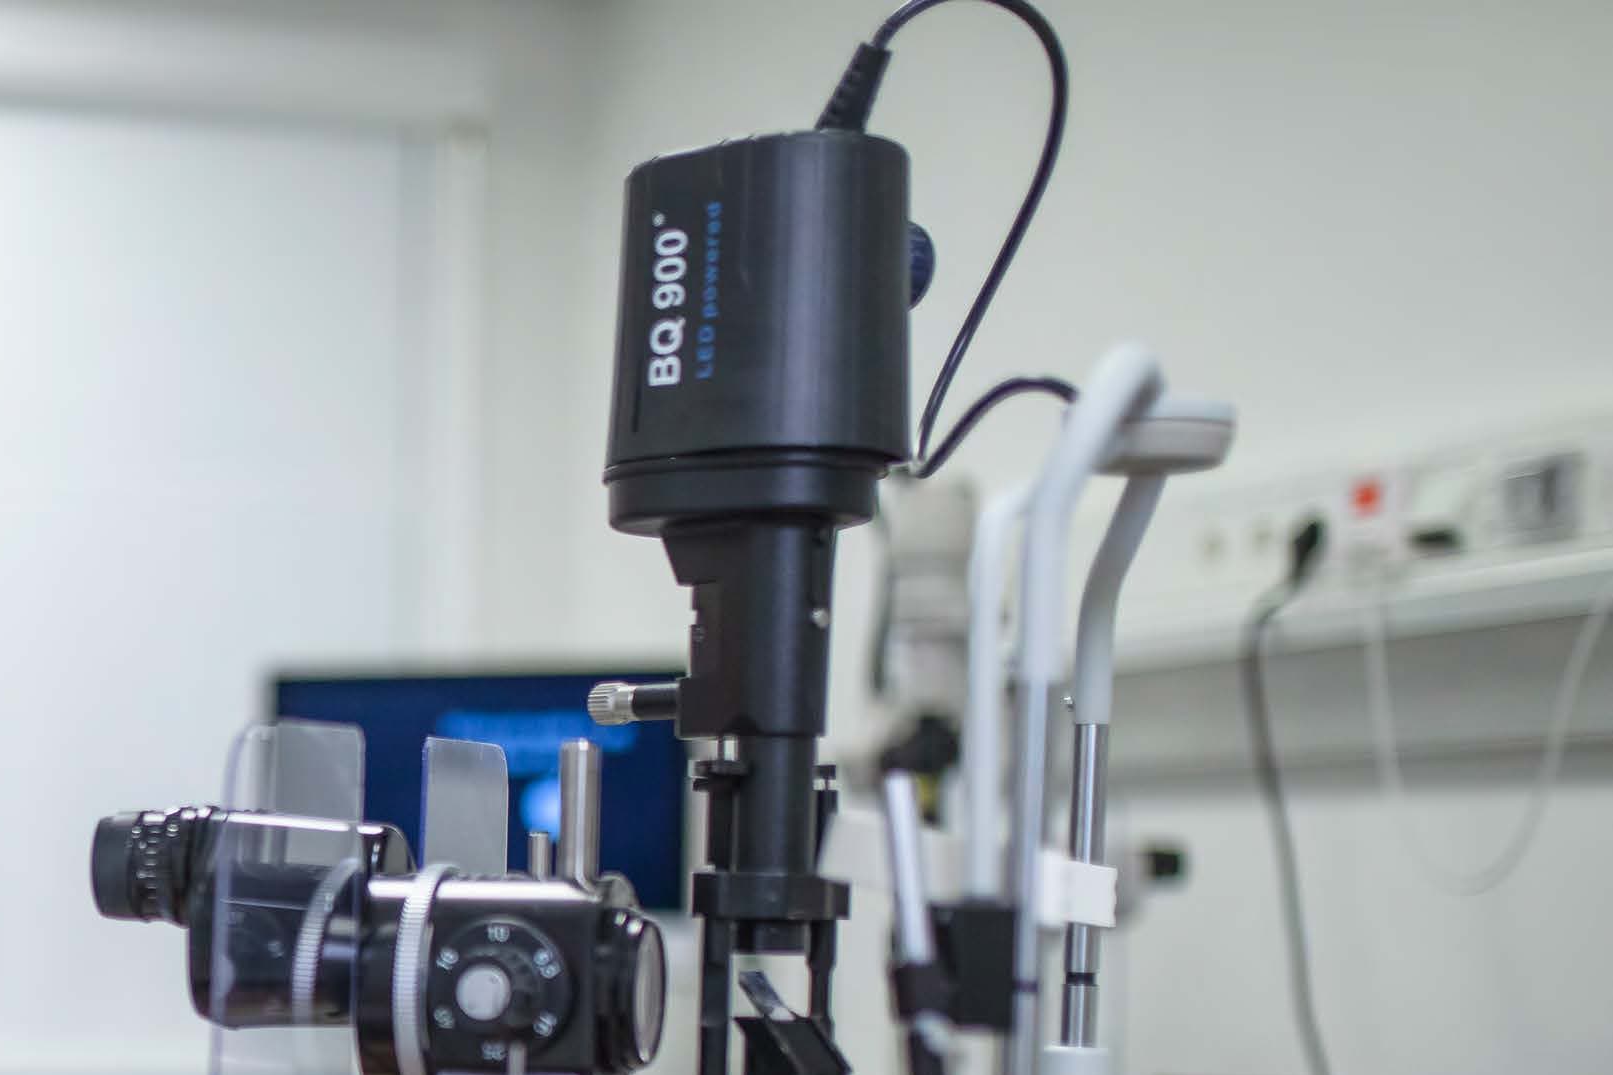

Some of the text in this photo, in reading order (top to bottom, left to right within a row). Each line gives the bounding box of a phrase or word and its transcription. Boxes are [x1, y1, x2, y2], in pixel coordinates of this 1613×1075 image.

[648, 316, 686, 387] BQ
[695, 201, 723, 380] LED powered
